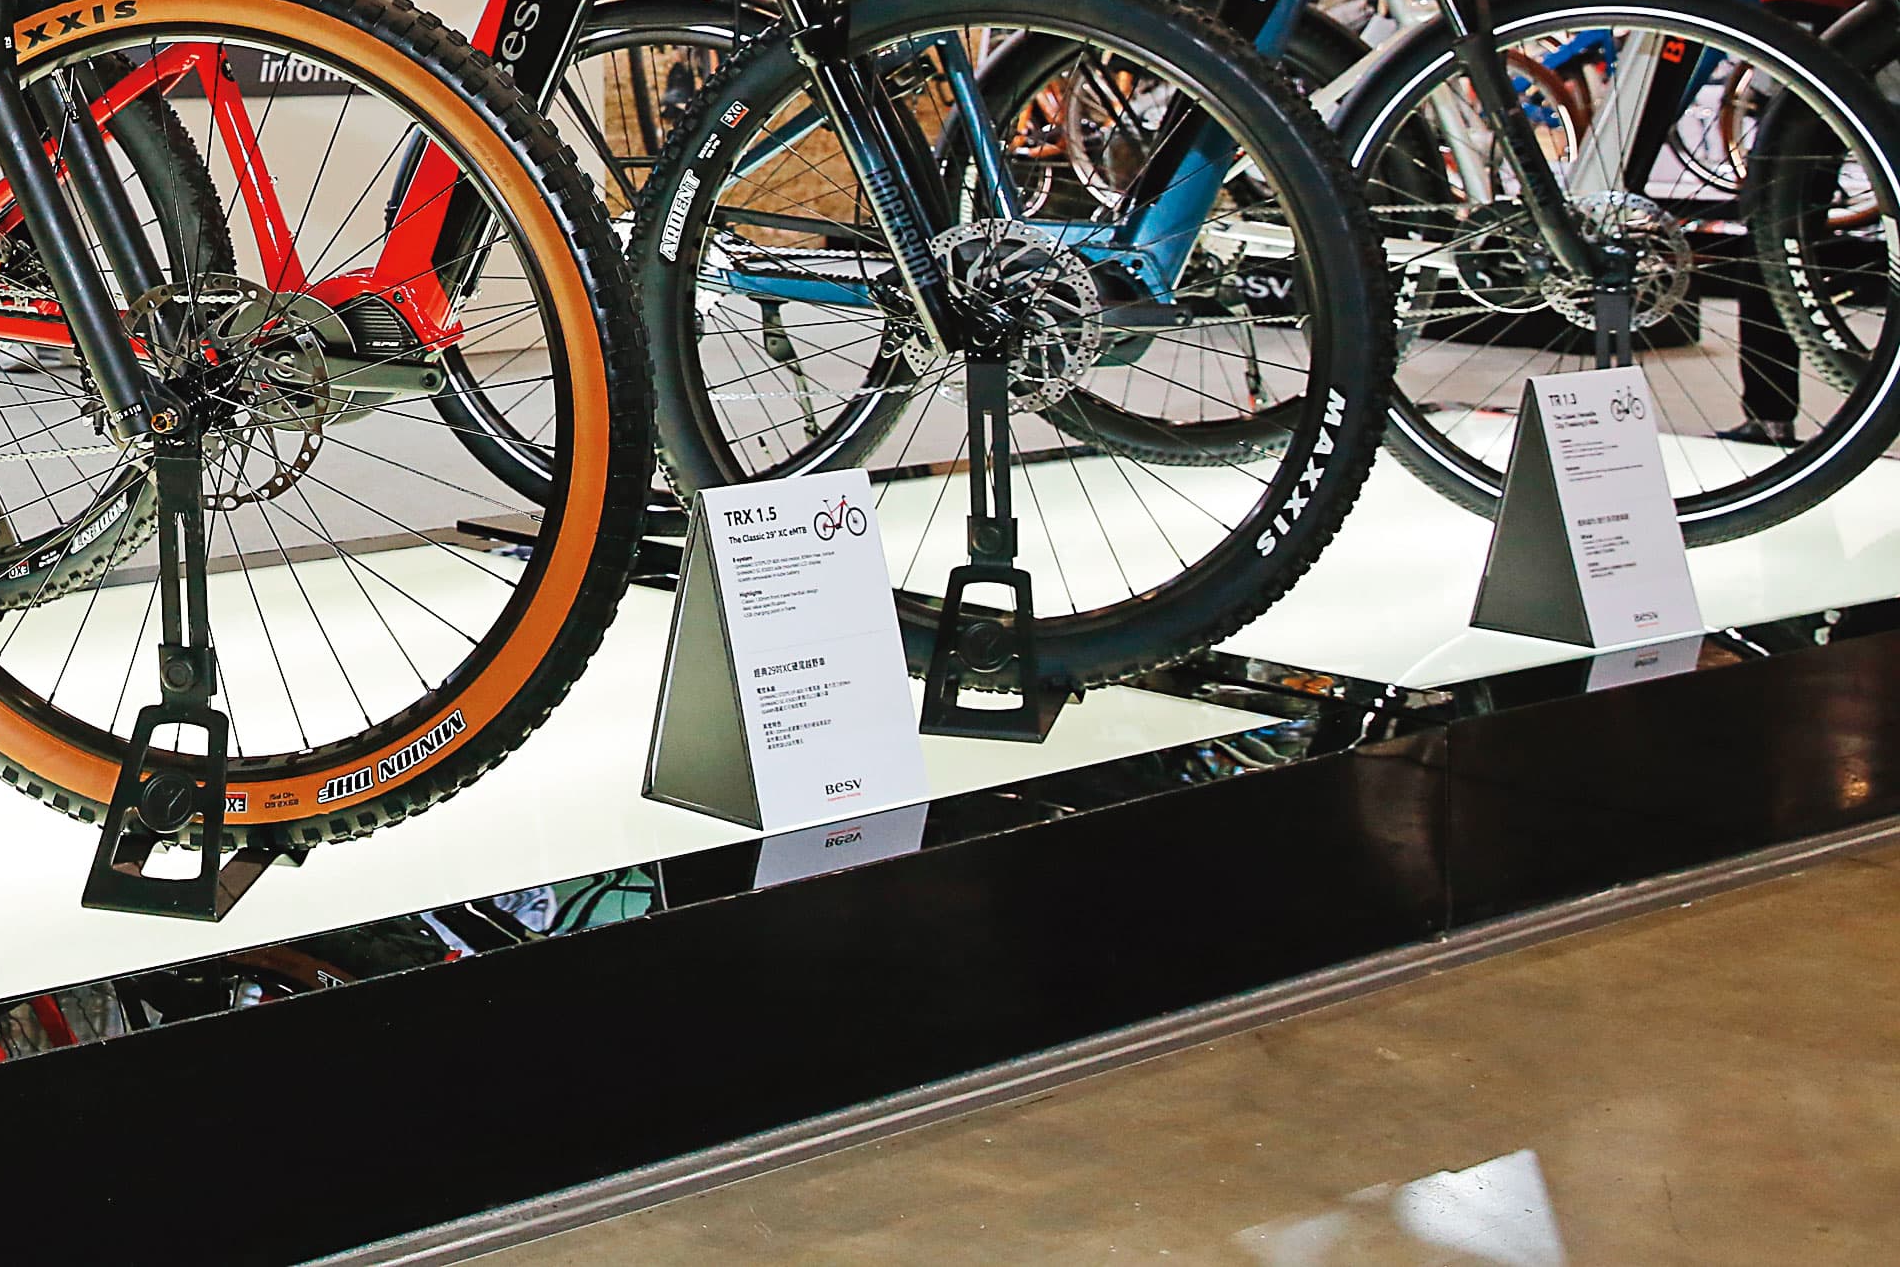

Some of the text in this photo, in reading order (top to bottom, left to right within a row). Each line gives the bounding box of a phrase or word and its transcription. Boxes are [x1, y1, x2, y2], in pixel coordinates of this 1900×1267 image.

[721, 101, 746, 125] EXO
[659, 168, 701, 262] ARDENT
[1255, 386, 1347, 558] MAXXIS
[724, 506, 777, 526] TRX 1.5
[729, 536, 741, 544] The
[742, 532, 765, 542] Classic
[778, 529, 788, 537] XC
[789, 526, 807, 535] eMTB
[315, 708, 468, 805] MINION DHF
